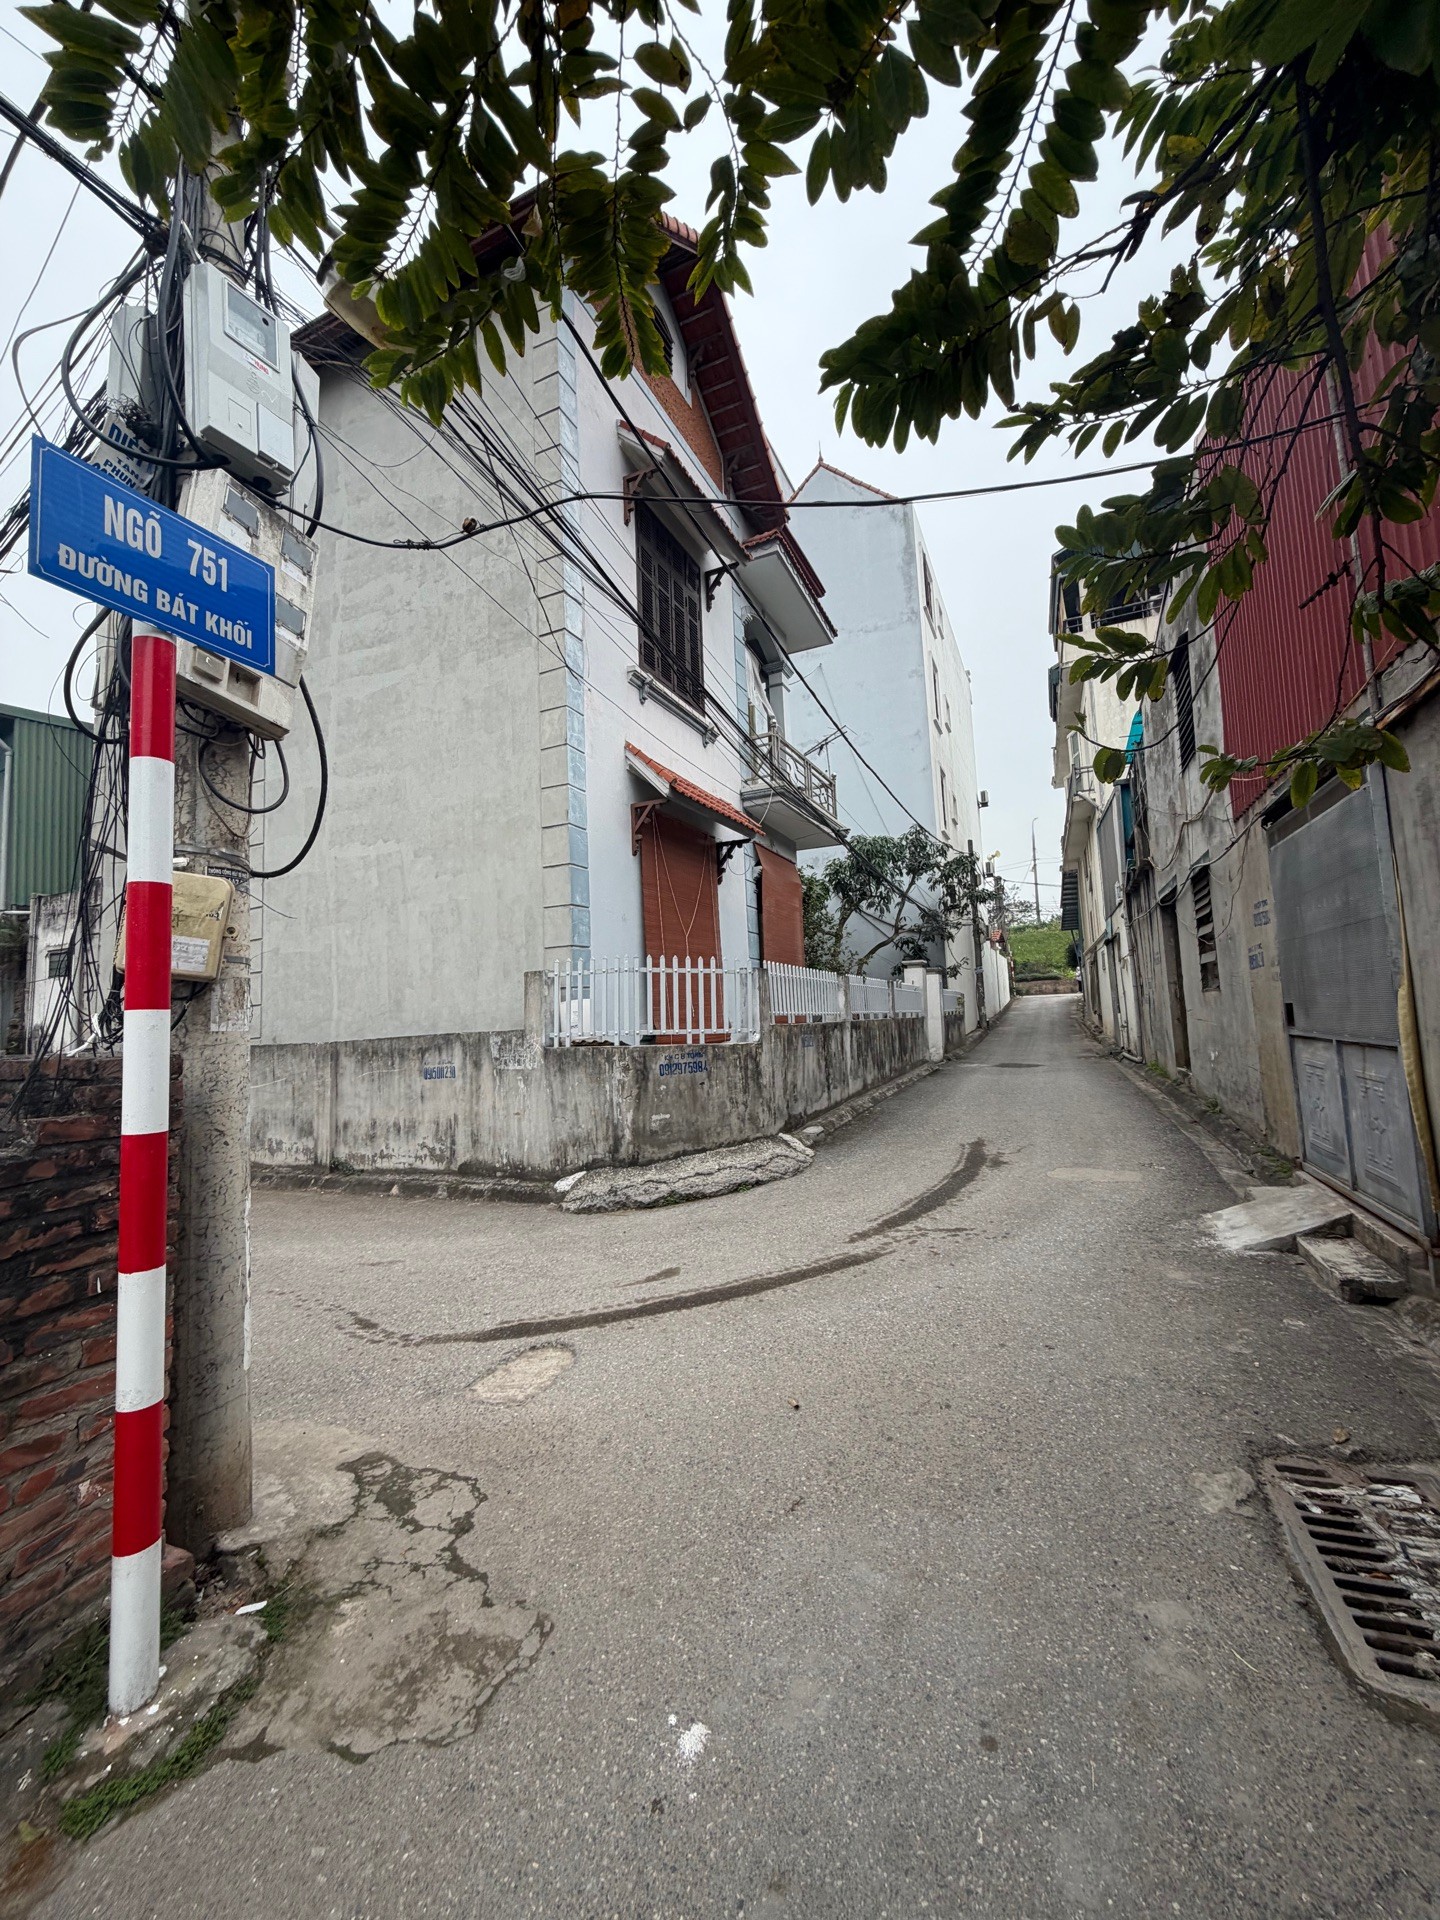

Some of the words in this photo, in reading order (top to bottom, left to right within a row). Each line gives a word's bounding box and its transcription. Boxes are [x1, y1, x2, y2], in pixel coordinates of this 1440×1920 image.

[104, 494, 162, 559] NGÕ
[187, 538, 228, 593] 751
[57, 543, 149, 604] ĐƯỜNG
[156, 592, 199, 625] BÁT
[205, 619, 253, 649] KHỐI
